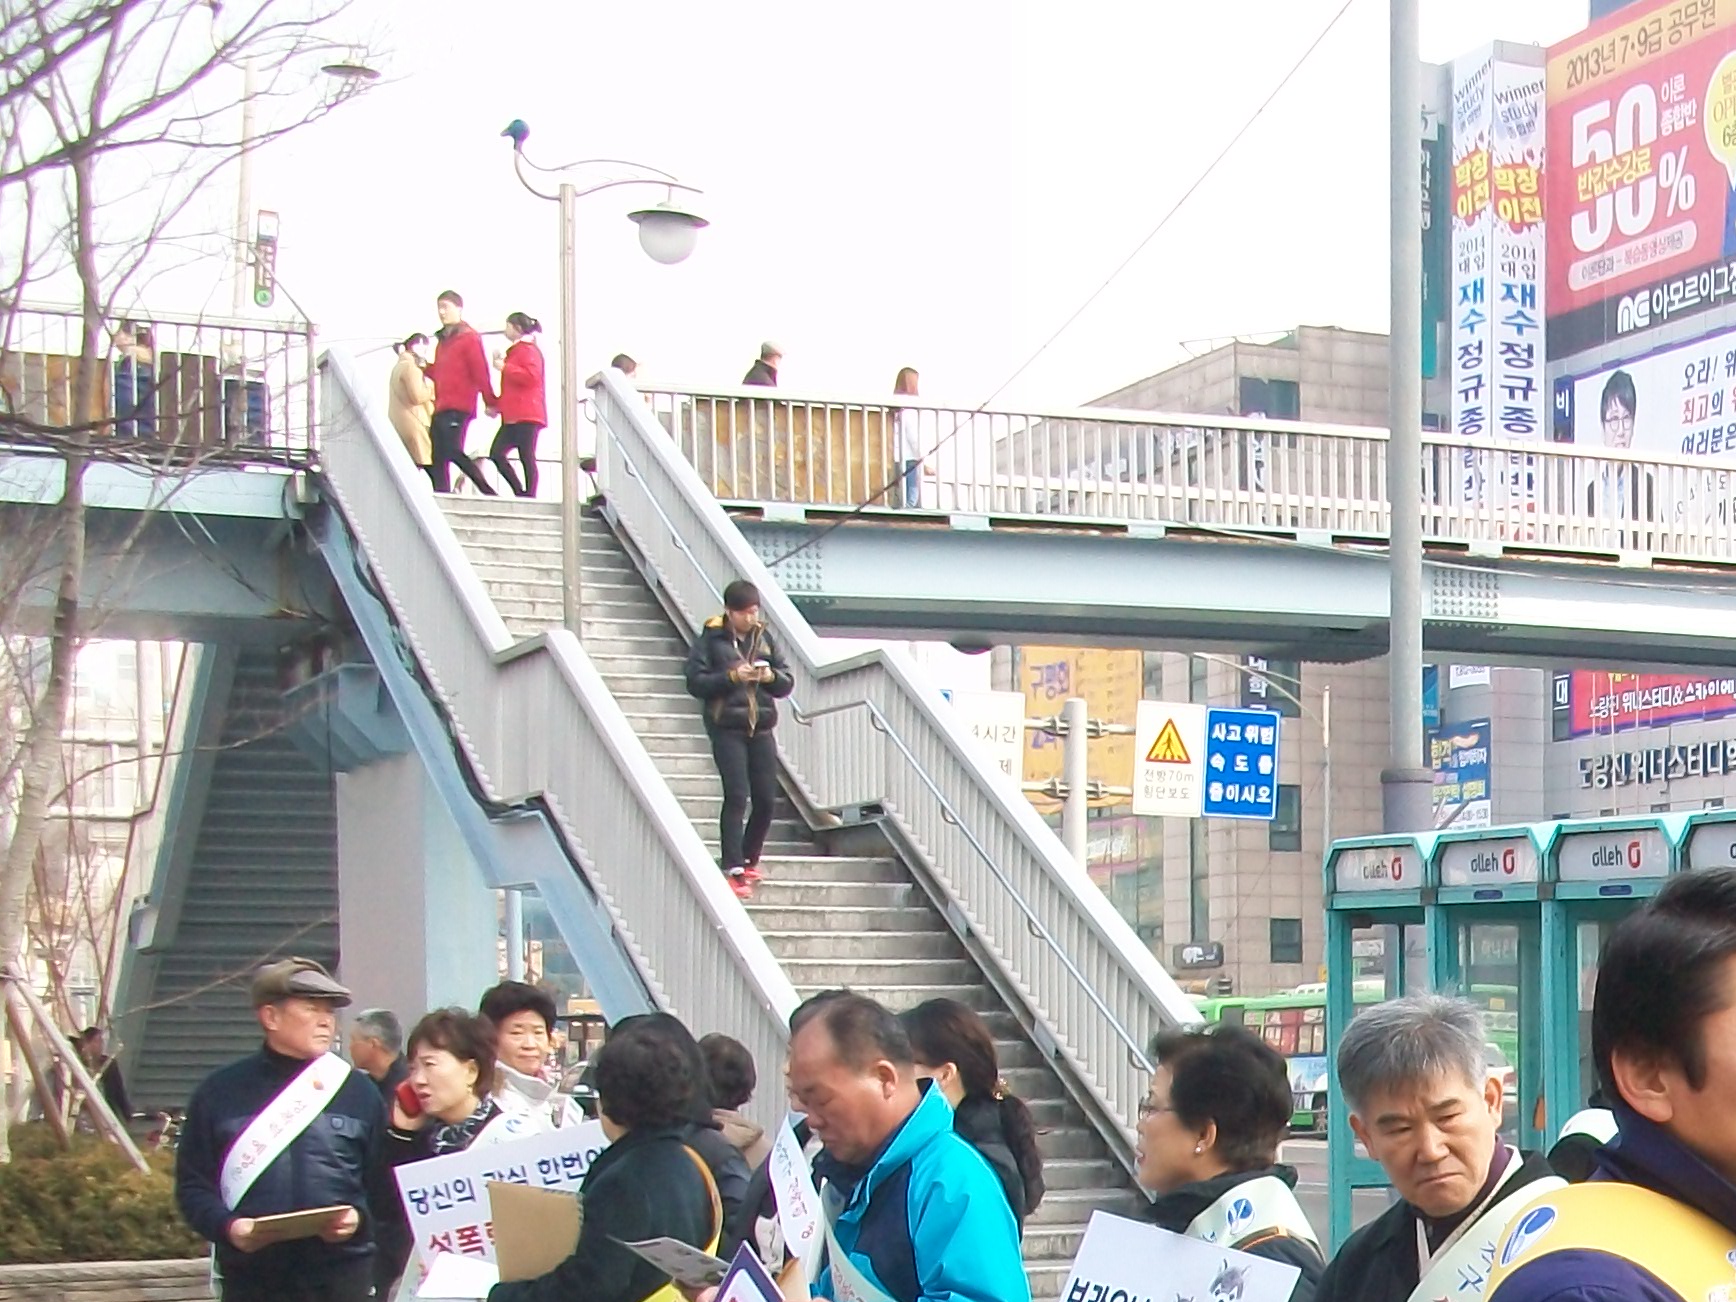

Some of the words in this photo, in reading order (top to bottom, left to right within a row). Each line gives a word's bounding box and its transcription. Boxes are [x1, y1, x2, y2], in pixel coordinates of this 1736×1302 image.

[1567, 38, 1616, 90] 2013년
[1495, 79, 1546, 105] winner
[1500, 99, 1539, 124] study
[1498, 196, 1543, 225] 이전
[1501, 243, 1537, 263] 2014
[1500, 260, 1537, 281] 대입
[1682, 355, 1719, 391] 오라!
[1211, 722, 1242, 743] 사고
[1208, 781, 1272, 804] 줄이시오
[1470, 851, 1499, 874] olleh
[1591, 845, 1625, 868] olleh
[408, 1176, 477, 1217] 당신의
